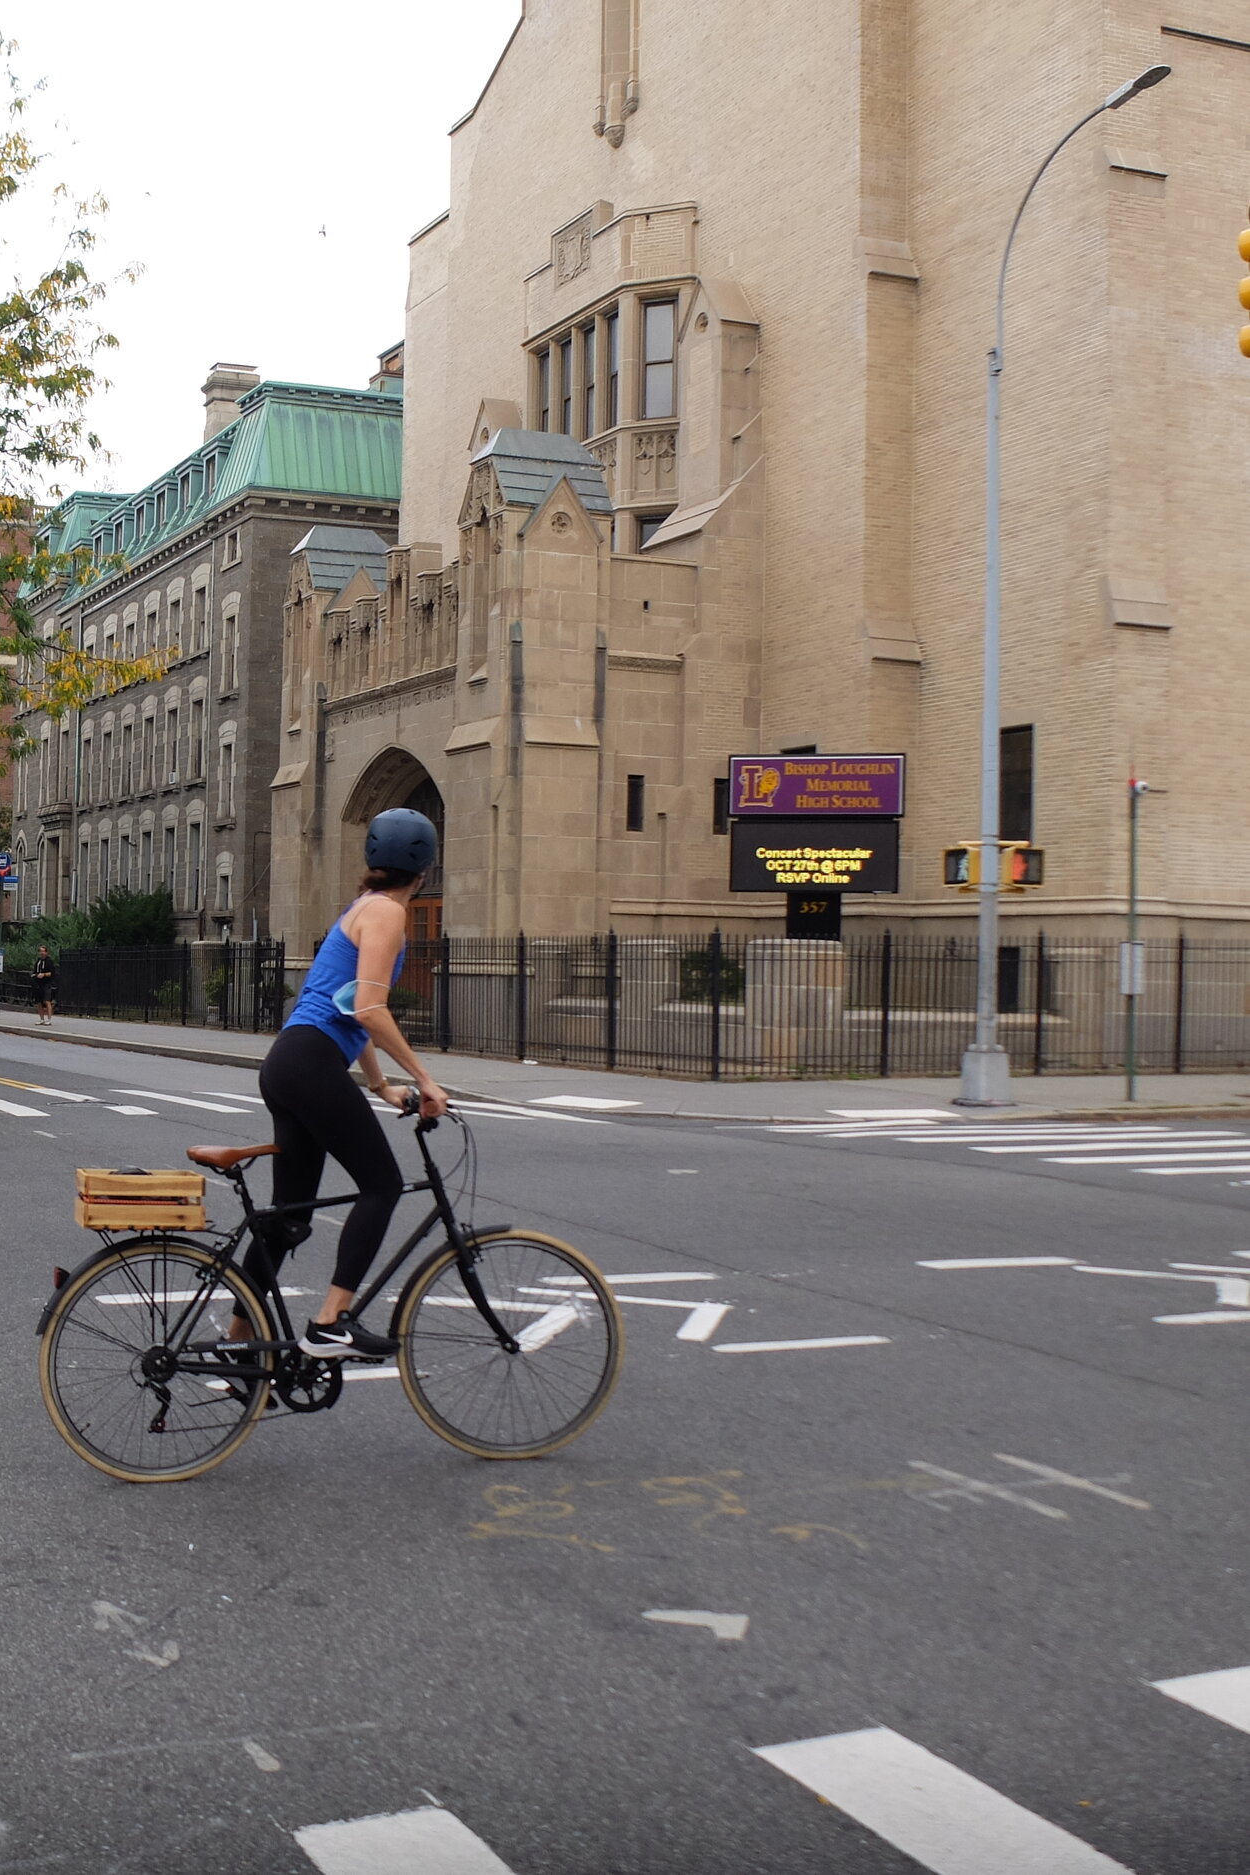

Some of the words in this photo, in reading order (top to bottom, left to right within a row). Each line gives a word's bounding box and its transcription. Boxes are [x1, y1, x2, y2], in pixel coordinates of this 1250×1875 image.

[784, 762, 829, 775] BISHOP
[831, 762, 896, 775] LOUGHLIN
[806, 779, 872, 792] MEMORIAL
[796, 795, 829, 808] HIGH
[831, 795, 882, 808] SCHOOL
[756, 847, 802, 859] Concert
[803, 847, 873, 860] Spectacular
[766, 860, 791, 871] OCT
[792, 860, 819, 871] 27th
[820, 860, 834, 873] @
[835, 860, 861, 871] 6PM
[776, 872, 810, 883] RSVP
[812, 872, 850, 883] Online
[799, 901, 828, 913] 357
